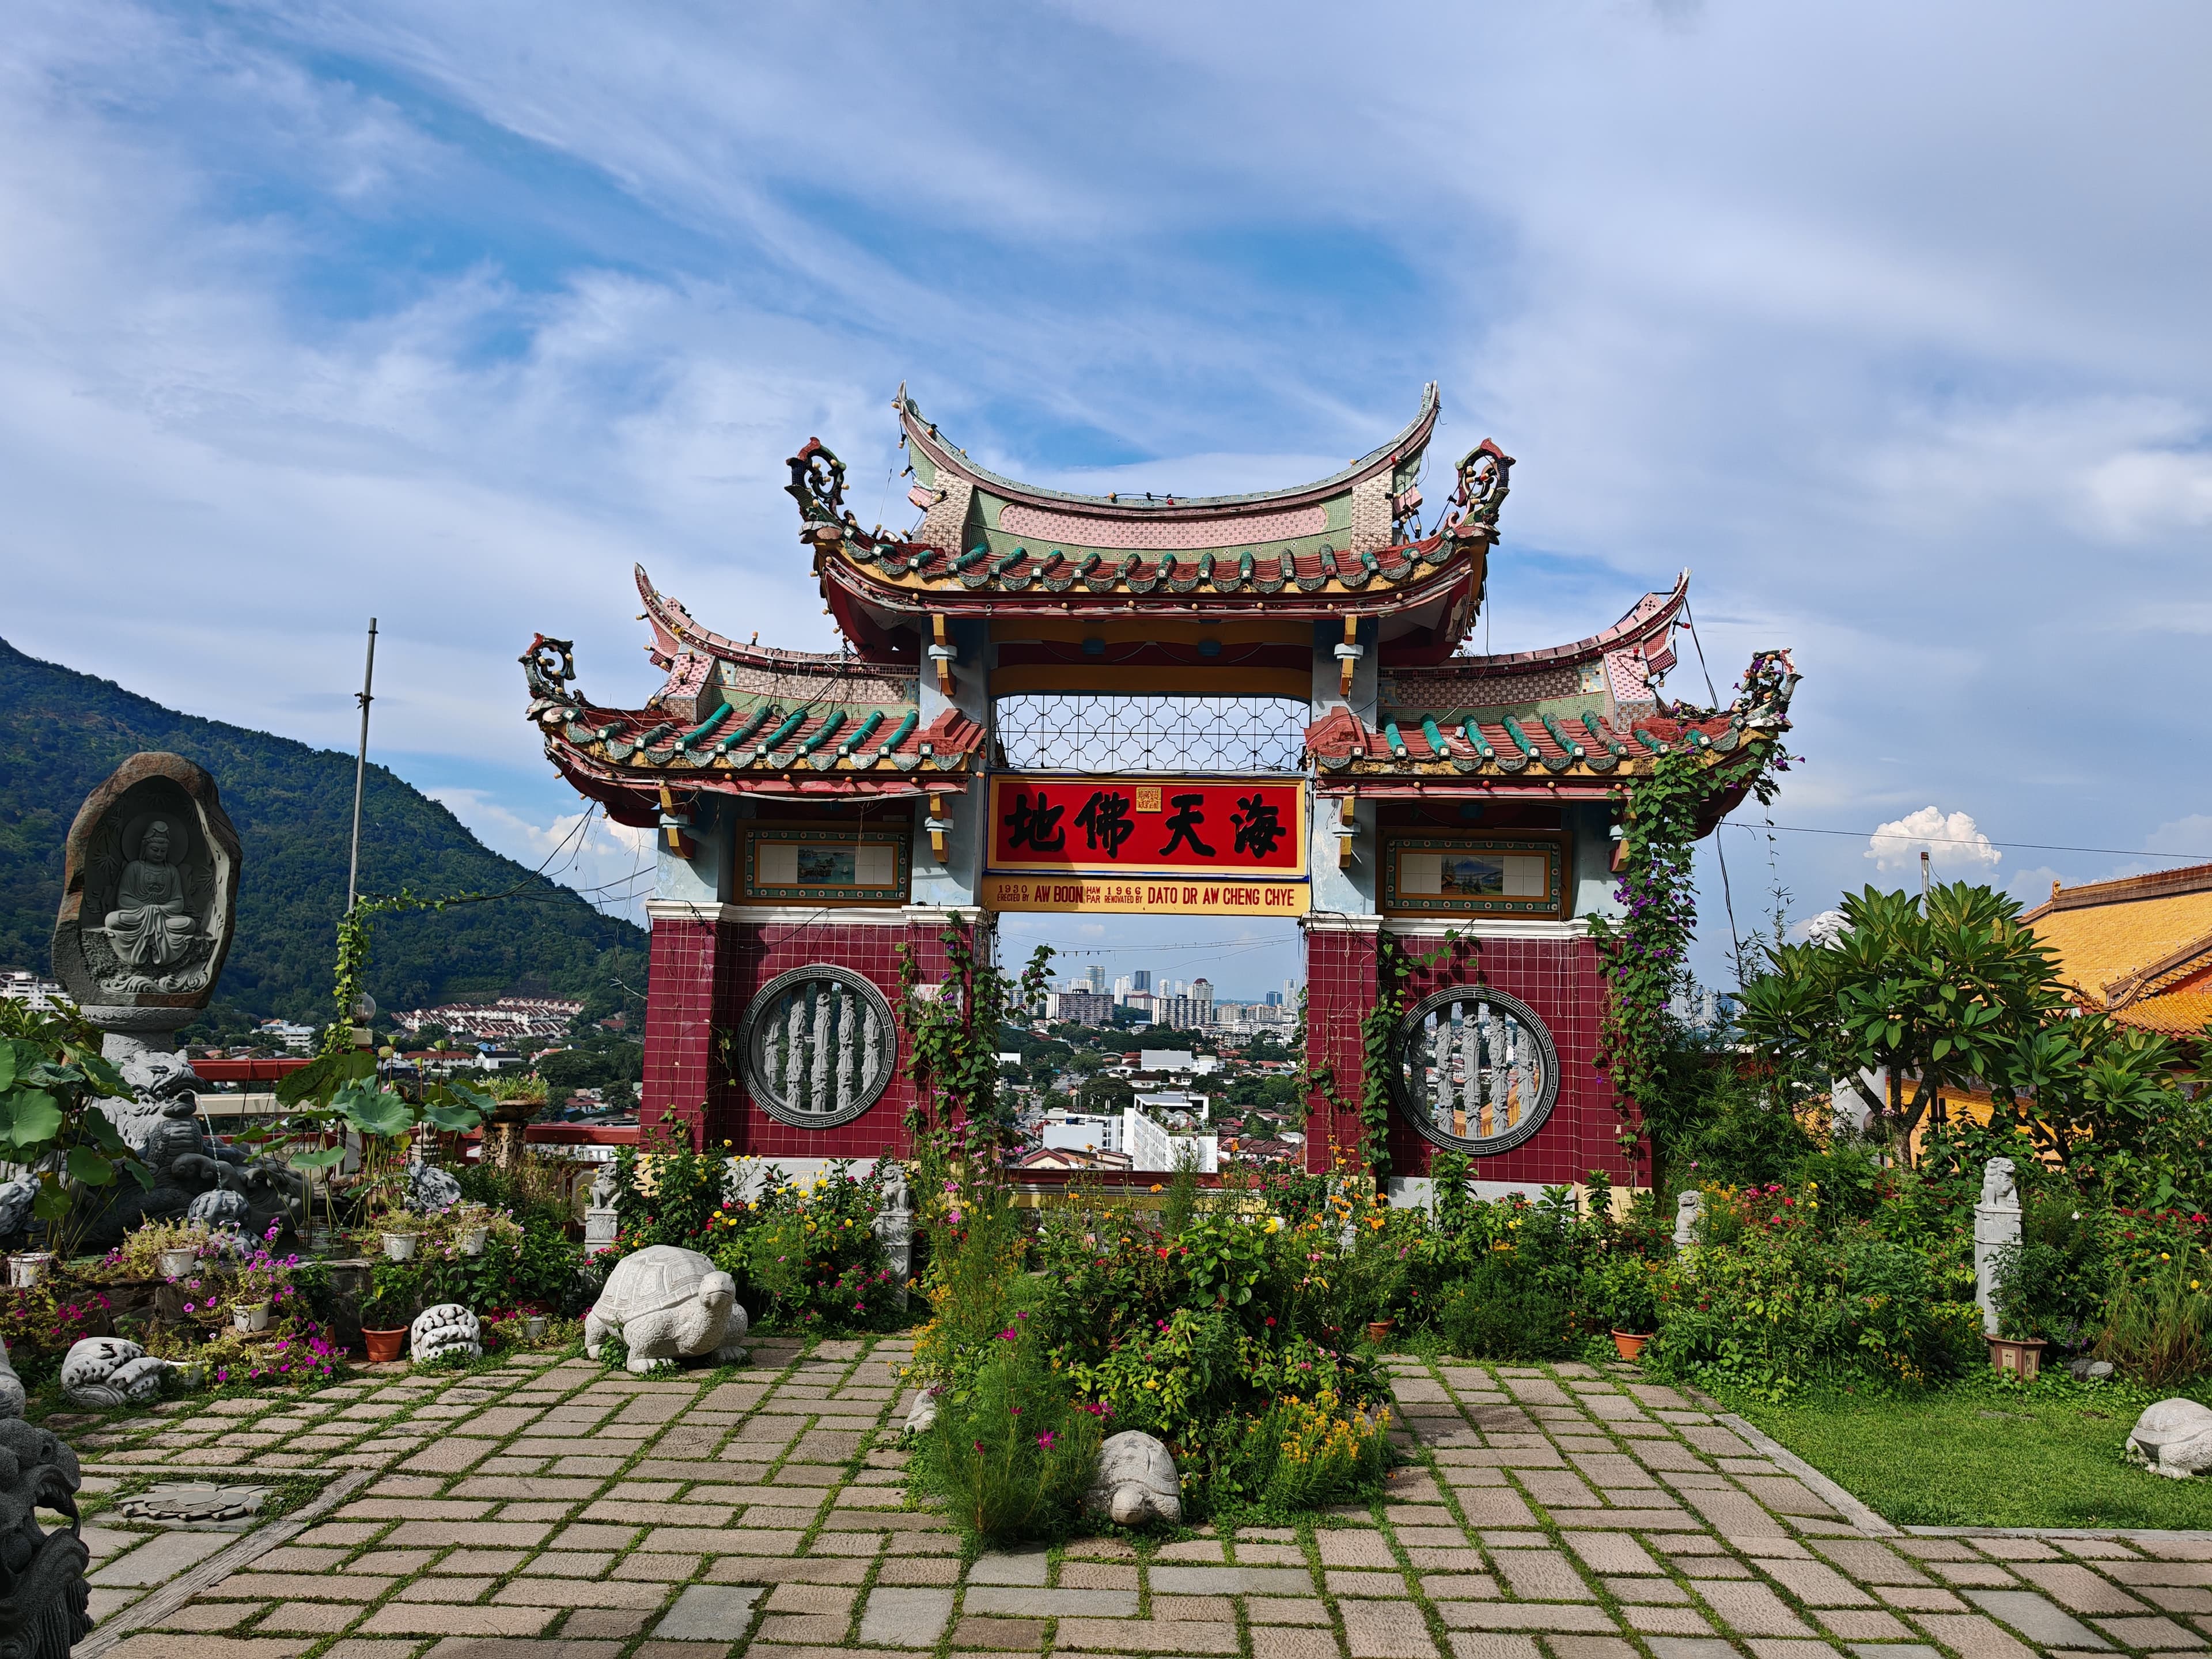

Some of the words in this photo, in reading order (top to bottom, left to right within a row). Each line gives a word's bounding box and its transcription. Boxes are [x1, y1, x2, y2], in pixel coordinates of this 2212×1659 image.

[998, 884, 1028, 893] 1930
[1086, 886, 1100, 895] HAW
[1107, 887, 1141, 895] 1966
[997, 893, 1020, 902] ERECTED
[1022, 894, 1029, 902] BY
[1034, 885, 1051, 903] AW
[1054, 885, 1084, 903] BOON
[1147, 887, 1178, 904] DATO
[1183, 887, 1198, 904] DR
[1203, 888, 1219, 904] AW
[1223, 888, 1260, 905] CHENG
[1264, 888, 1294, 906] CHYE
[1086, 895, 1100, 903] PAR
[1104, 895, 1134, 903] RENOVATED
[1135, 895, 1143, 903] BY
